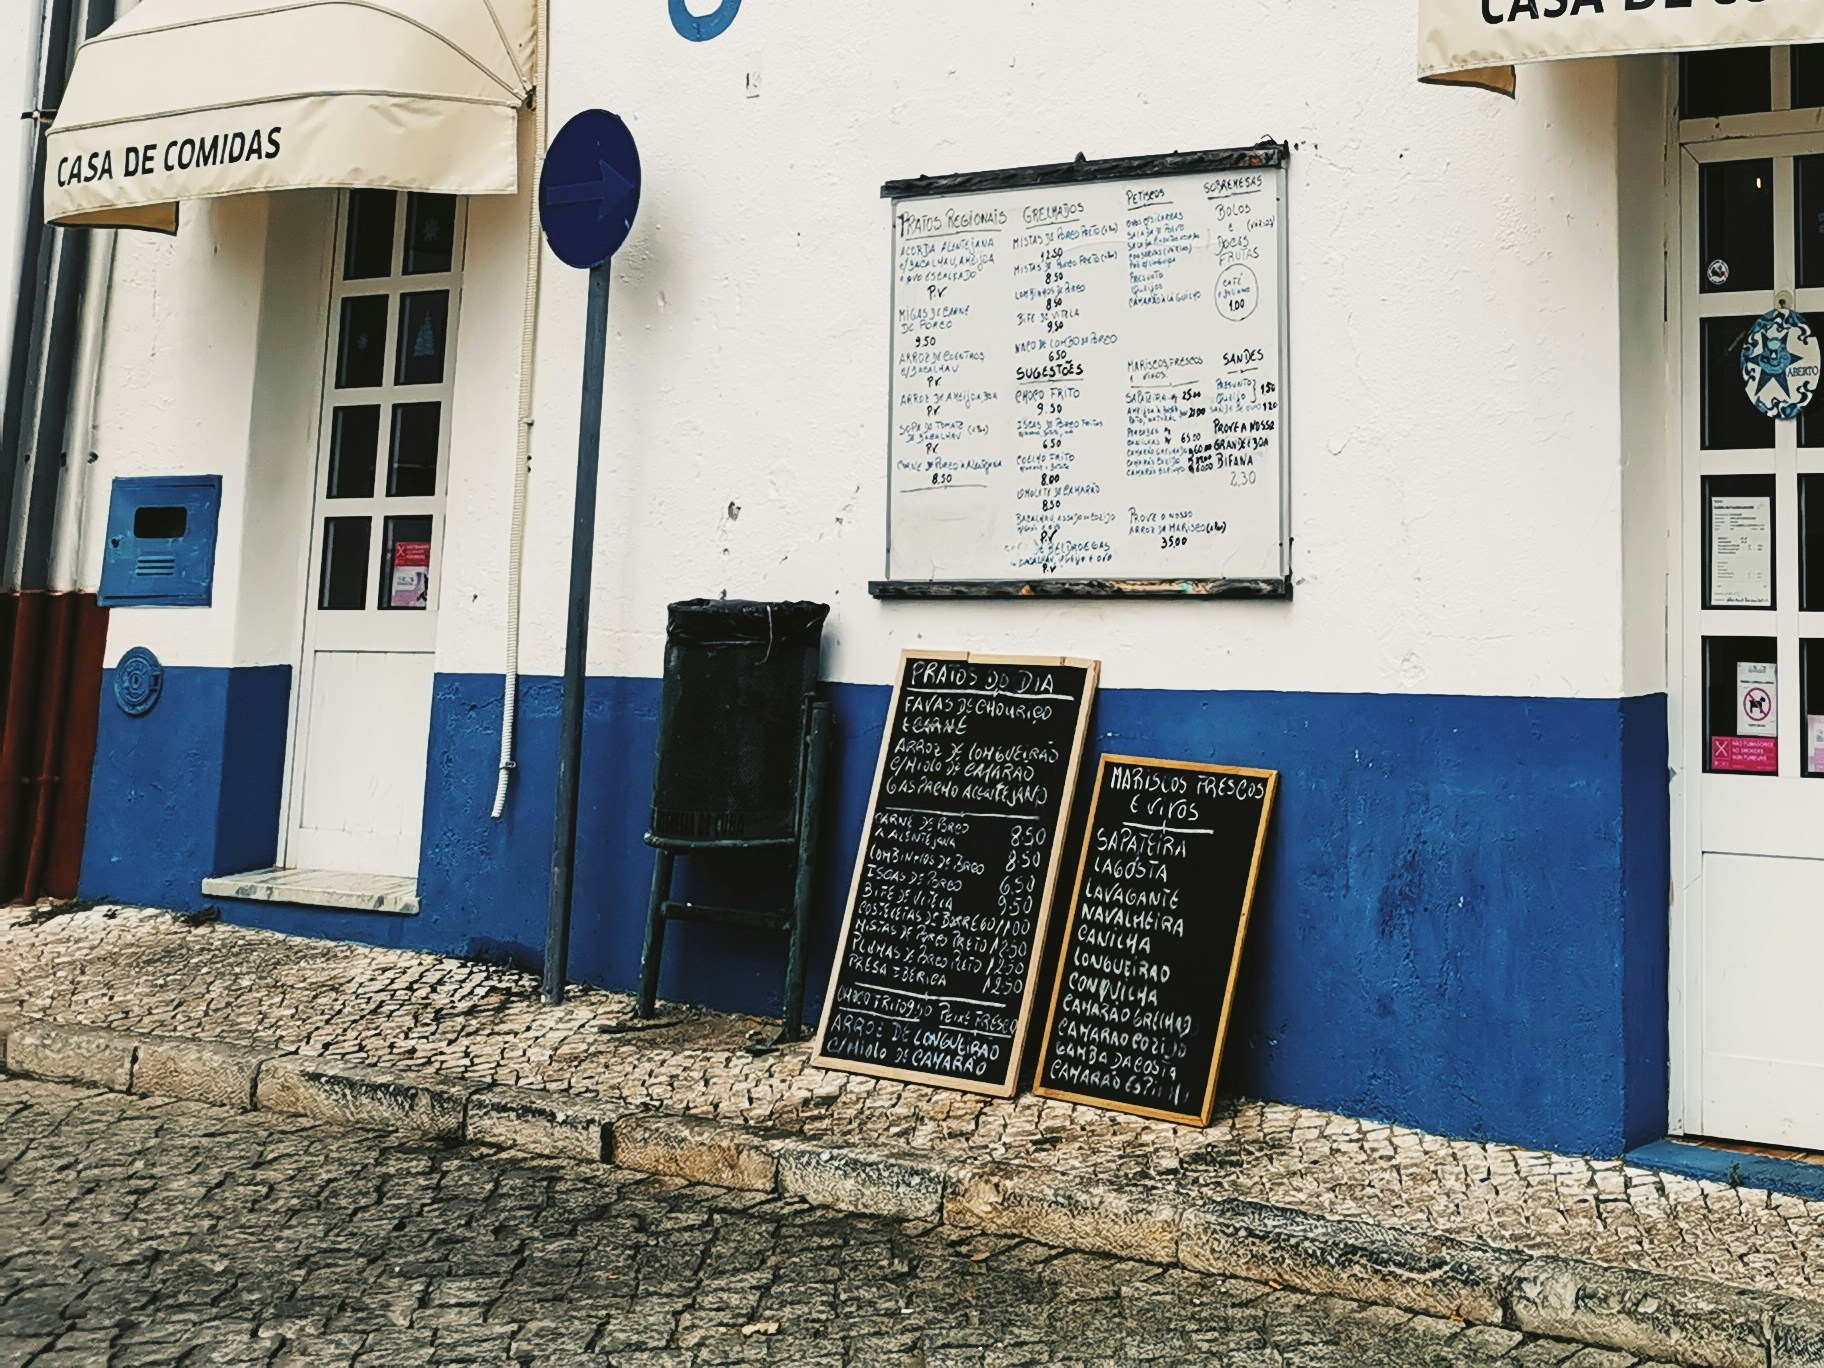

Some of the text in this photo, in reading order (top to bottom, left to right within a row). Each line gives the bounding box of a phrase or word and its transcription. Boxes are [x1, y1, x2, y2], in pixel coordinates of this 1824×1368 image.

[57, 126, 282, 187] CASA DE COMIDAS
[1204, 175, 1262, 194] SOBREMESAS
[897, 208, 1007, 238] PRATOS REGIONAIS
[1215, 204, 1250, 221] BOLOS
[1219, 247, 1259, 266] FRUTAS
[1223, 348, 1264, 366] SANDES
[1016, 360, 1084, 380] SUGESTÕES
[1787, 365, 1819, 377] ABERTO
[1050, 388, 1080, 400] FRITO
[1216, 453, 1253, 468] BIFANA
[912, 661, 1054, 693] PRATOS DO DIA
[904, 695, 953, 713] FAVAS
[894, 738, 942, 757] ARROZ
[1110, 766, 1264, 800] MARISCOS FRESCOS
[1130, 794, 1199, 821] E VIVOS
[874, 812, 912, 828] CARNE
[1011, 825, 1046, 847] 8.50
[1096, 827, 1186, 857] SAPATEIRA
[1005, 850, 1041, 872] 8.50
[1094, 856, 1167, 882] LAGOSTA
[867, 864, 906, 882] ISCAS
[1000, 875, 1035, 896] 6.50
[1085, 878, 1179, 909] LAVAGANTE
[998, 895, 1033, 916] 9.50
[1081, 903, 1184, 937] NAVALHEIRA
[1078, 924, 1150, 955] CANILHA
[849, 954, 887, 976] PRESA
[939, 1002, 970, 1025] PEIXE
[892, 1022, 910, 1042] DE
[1056, 1040, 1108, 1064] GAMBA
